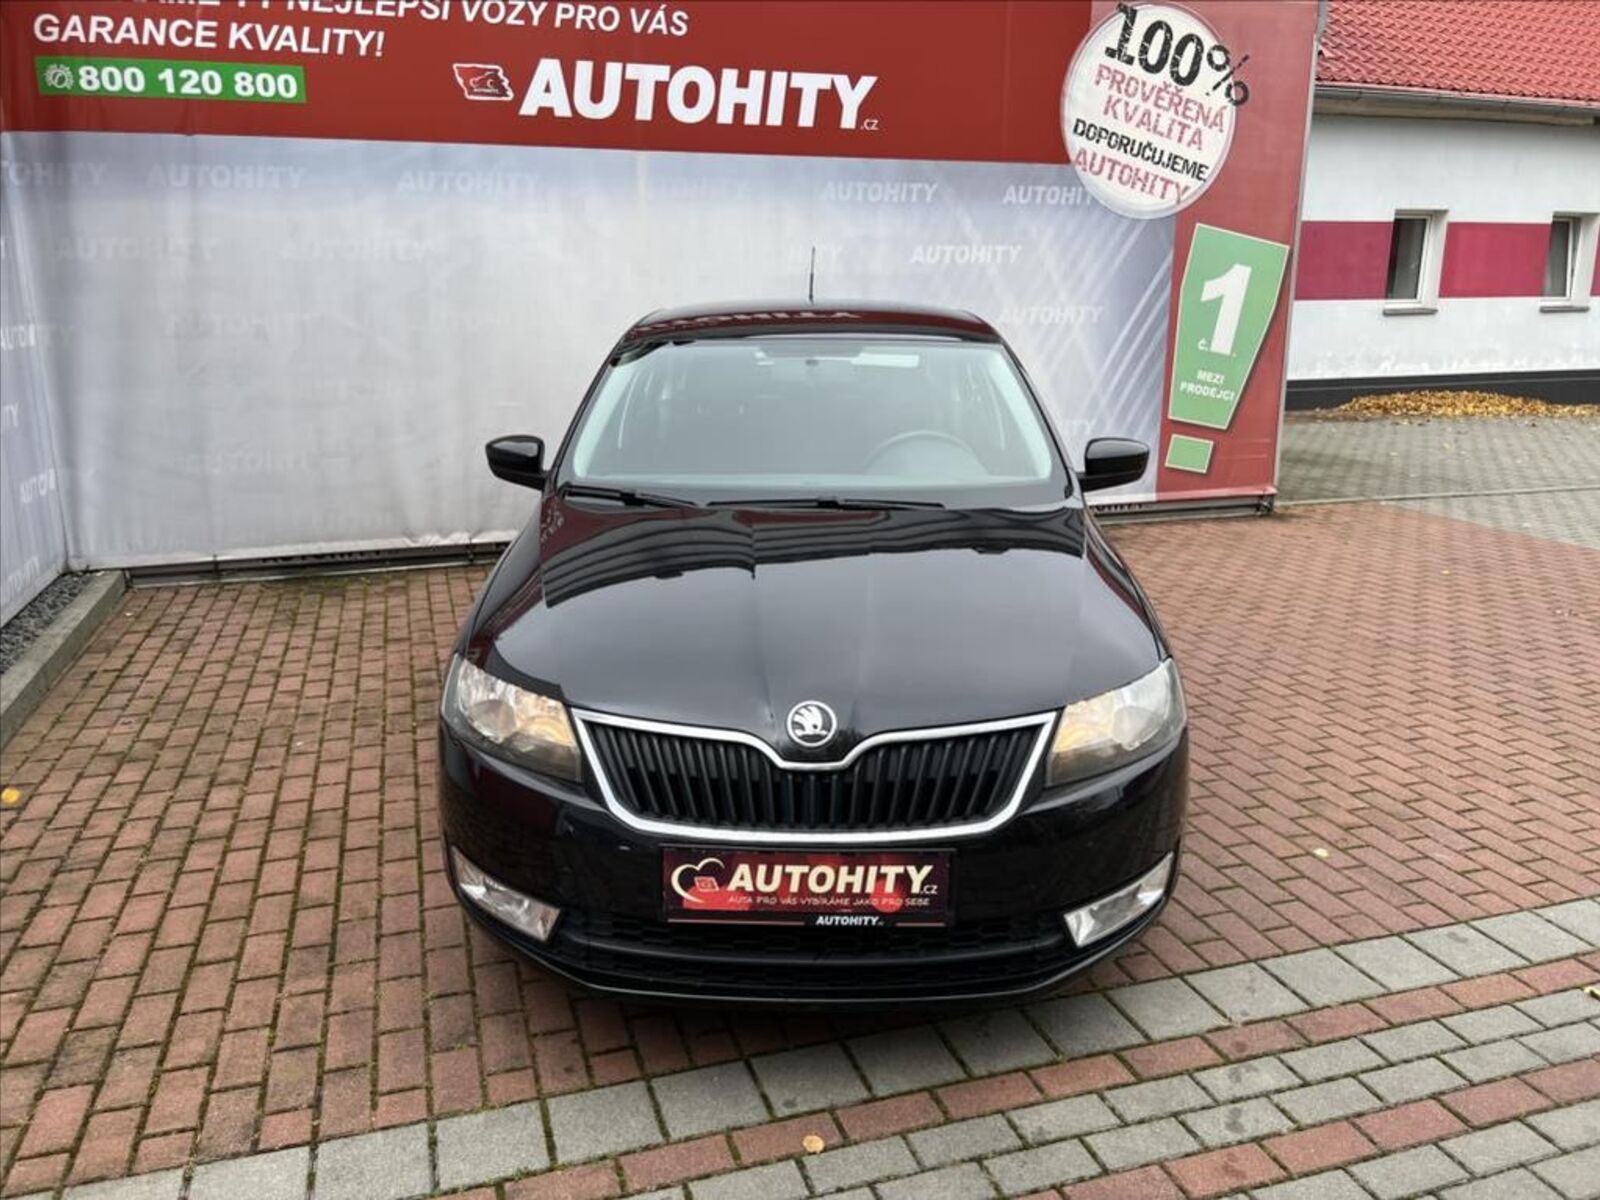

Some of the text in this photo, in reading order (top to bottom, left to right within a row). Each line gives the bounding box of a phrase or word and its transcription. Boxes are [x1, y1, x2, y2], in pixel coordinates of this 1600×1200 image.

[461, 0, 548, 27] VOZY
[554, 3, 620, 32] PRO
[629, 4, 689, 36] VÁS
[33, 13, 386, 58] GARANCE KVALITY!
[1104, 2, 1250, 107] 100%
[78, 65, 298, 99] 800 120 800
[1095, 63, 1228, 133] PROVĚŘENÁ
[1103, 95, 1204, 151] KVALITA
[1073, 118, 1209, 182] DOPORUČUJEME
[146, 163, 305, 189] AUTOHITY
[396, 169, 540, 194] AUTOHITY
[1074, 148, 1192, 205] AUTOHITY
[821, 180, 939, 204] AUTOHITY
[910, 244, 1022, 265] AUTOHITY
[1000, 305, 1104, 325] AUTOHITY
[1180, 381, 1235, 401] PRODEJCI
[1197, 369, 1225, 386] MEZI
[756, 896, 777, 905] PRO
[905, 897, 930, 906] SEBE
